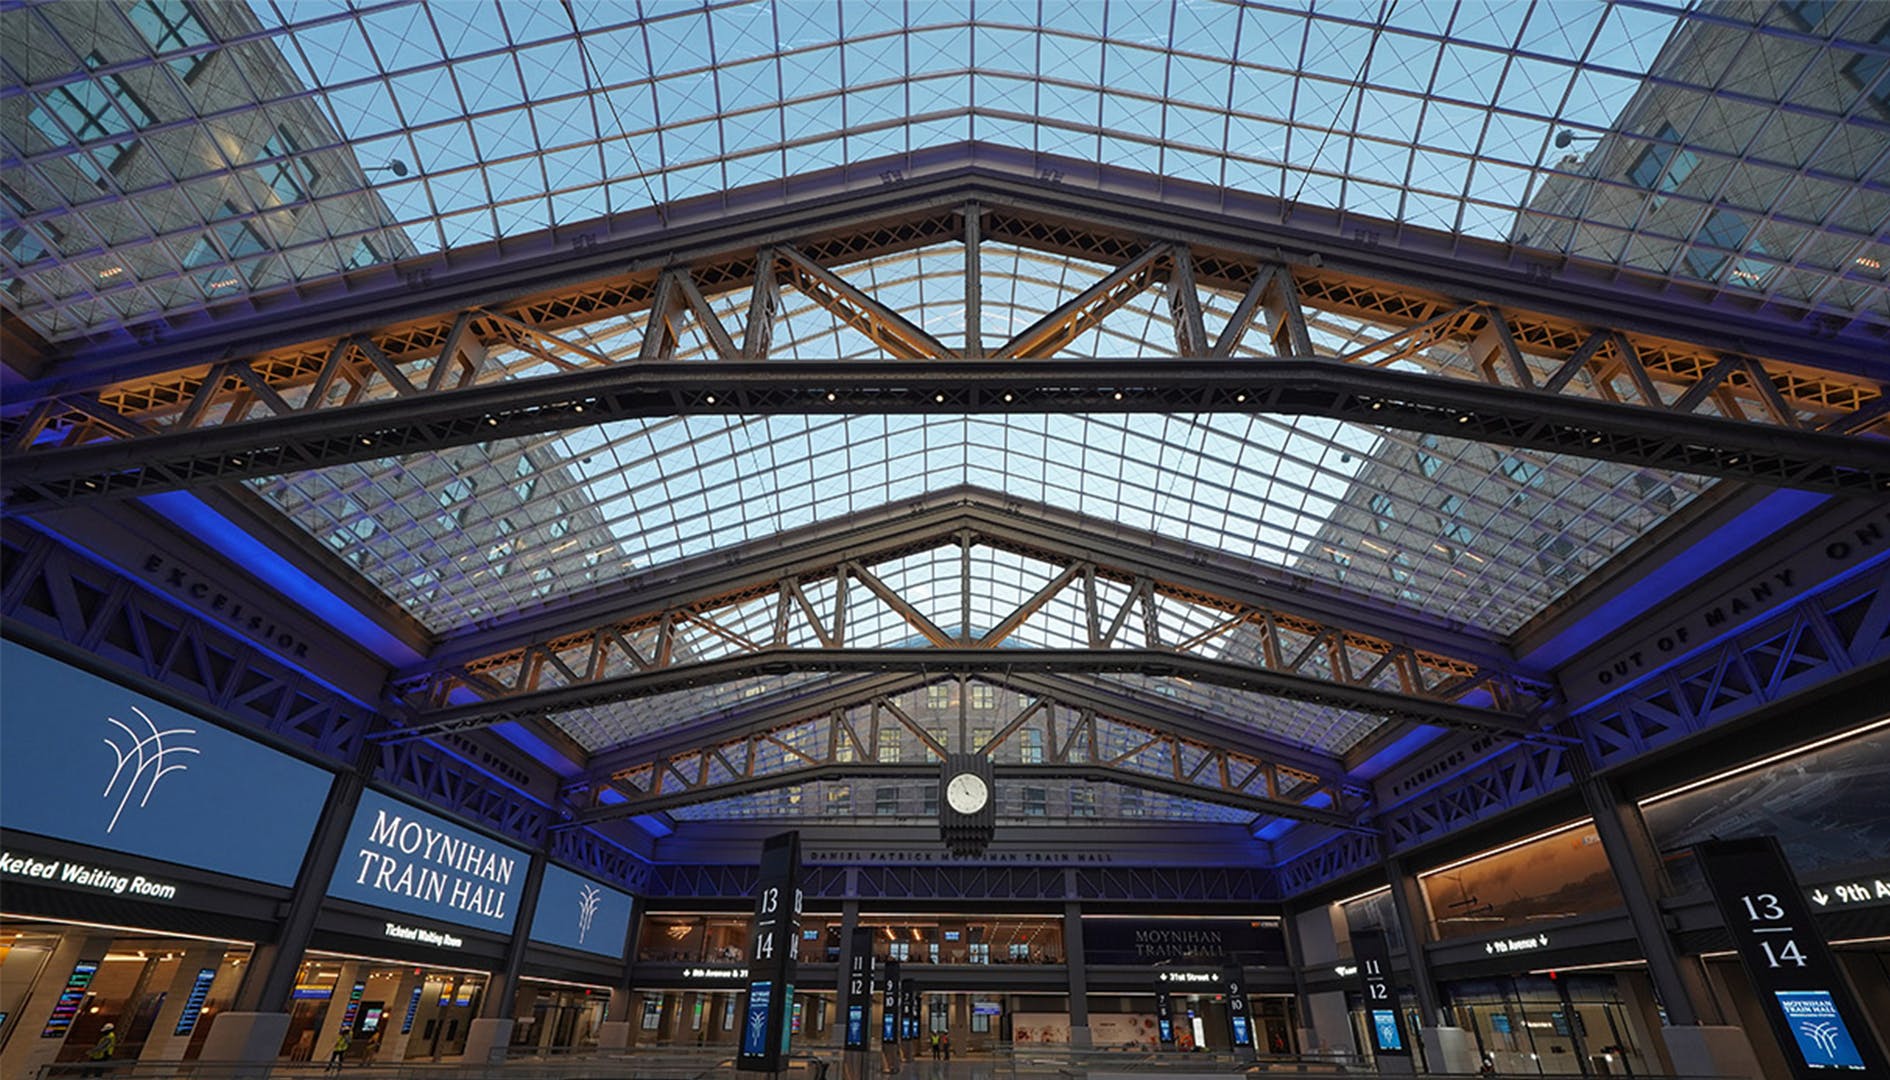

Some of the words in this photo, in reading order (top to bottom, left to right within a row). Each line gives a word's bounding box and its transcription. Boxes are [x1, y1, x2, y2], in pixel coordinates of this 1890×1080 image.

[143, 553, 308, 658] EXCELSIOR
[1598, 652, 1643, 685] OUT
[1657, 627, 1689, 652] OF
[1703, 569, 1795, 627] MANY
[1826, 513, 1890, 560] ON
[368, 809, 514, 885] MOYNIHAN
[811, 852, 861, 861] DANIEL
[870, 852, 932, 861] PATRICK
[1025, 853, 1069, 861] TRAIN
[1077, 853, 1113, 861] HALL
[61, 863, 129, 894] Waiting
[129, 876, 176, 899] Room
[356, 849, 448, 903] TRAIN
[449, 878, 506, 919] HALL
[761, 887, 779, 914] 13
[1834, 883, 1871, 904] 9th
[1741, 893, 1785, 921] 13
[385, 922, 418, 940] Ticketed
[418, 929, 443, 946] Waiting
[443, 933, 463, 947] Room
[1136, 930, 1222, 943] MOYNIHAN
[756, 932, 773, 960] 14
[1135, 944, 1183, 957] TRAIN
[1186, 944, 1224, 957] HALL
[1508, 938, 1538, 951] Avenue
[1760, 940, 1807, 968] 14
[853, 956, 863, 970] 11
[1365, 960, 1380, 974] 11
[705, 969, 731, 978] Avenue
[1169, 972, 1186, 982] 31st
[1186, 972, 1210, 982] Street
[851, 980, 863, 994] 12
[1229, 983, 1239, 994] 9
[1369, 983, 1388, 999] 12
[886, 996, 895, 1007] 10
[1231, 999, 1243, 1010] 10
